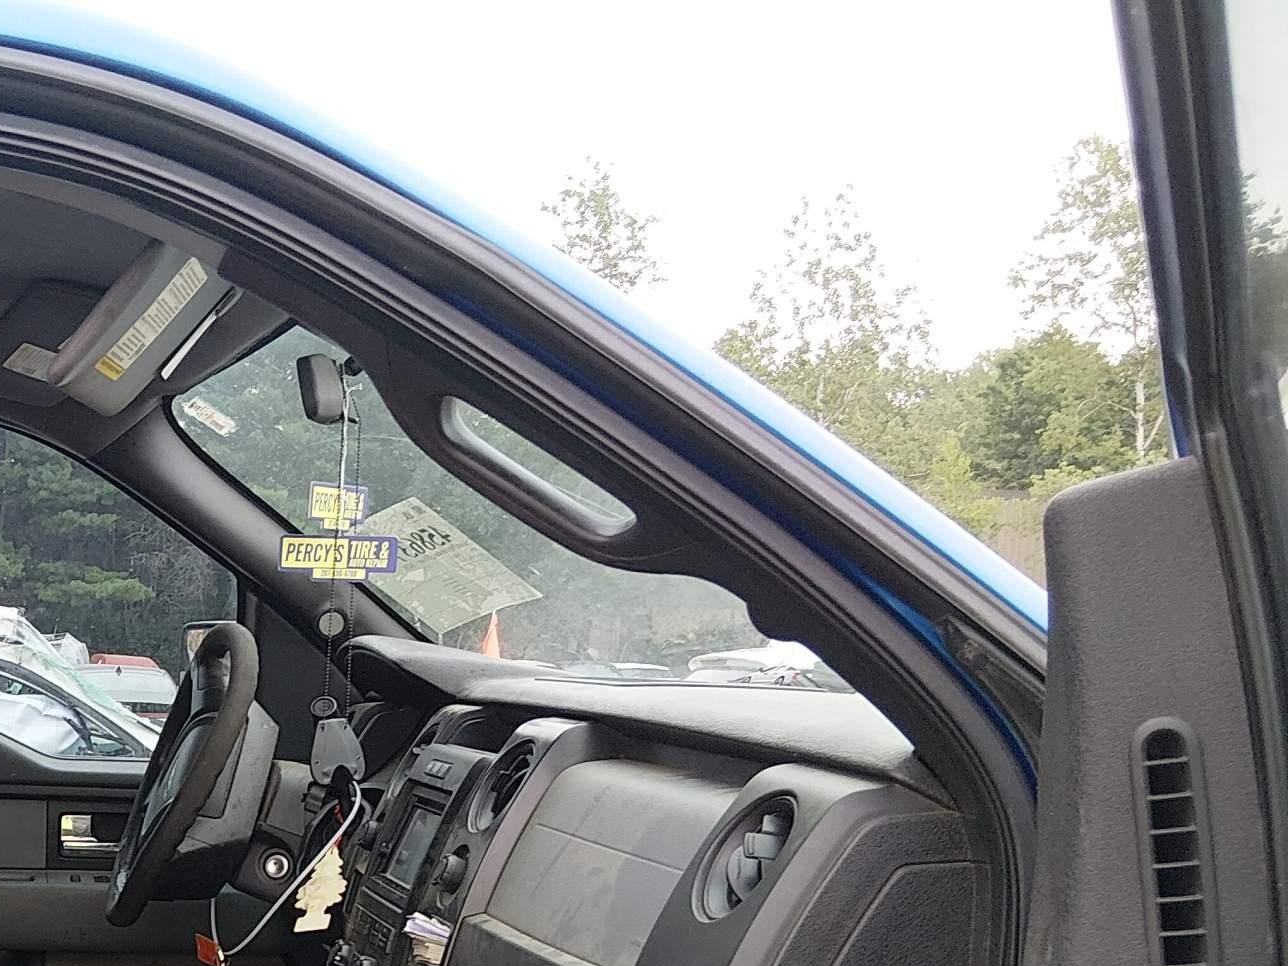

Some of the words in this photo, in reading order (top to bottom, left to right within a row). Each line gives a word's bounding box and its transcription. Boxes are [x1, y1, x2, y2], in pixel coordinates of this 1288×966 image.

[285, 543, 345, 563] PERCY'S
[350, 541, 379, 559] TIRE
[379, 541, 390, 559] &
